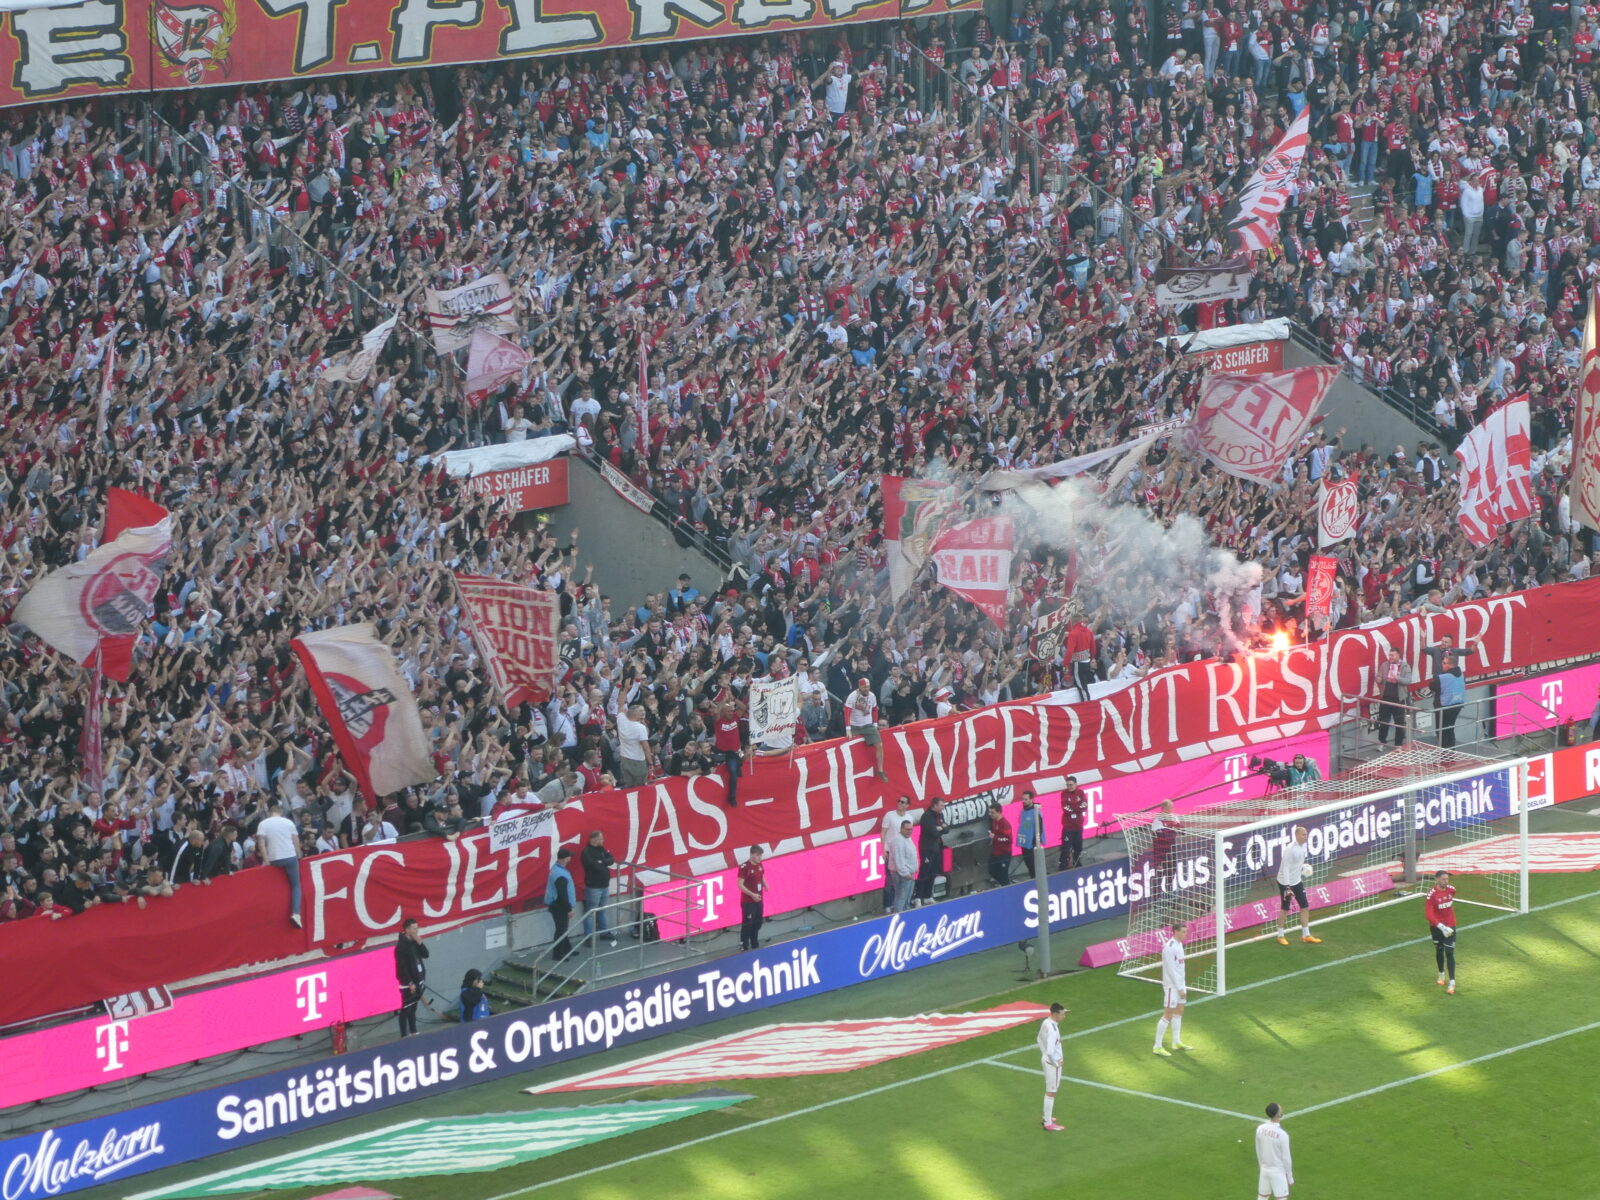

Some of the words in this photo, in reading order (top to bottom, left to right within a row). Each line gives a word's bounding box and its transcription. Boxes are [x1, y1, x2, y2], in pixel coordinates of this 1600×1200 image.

[1225, 345, 1269, 369] SCHÄFER
[495, 465, 550, 492] SCHÄFER
[1541, 679, 1563, 720] T
[309, 849, 405, 942] FC
[609, 773, 728, 870] JAS
[794, 737, 884, 830] HE
[893, 703, 1082, 800] WEED
[1096, 668, 1191, 761] NIT
[1204, 594, 1528, 733] RESIGNIERT
[1224, 752, 1248, 796] T
[1517, 797, 1548, 811] BDESLIGA
[493, 820, 520, 837] STARK
[858, 912, 985, 978] Malzkorn
[1245, 778, 1495, 872] Ortopädie-echnik
[860, 837, 886, 882] T
[696, 875, 724, 923] T
[296, 971, 328, 1022] T
[96, 1020, 129, 1073] T
[2, 1128, 165, 1200] Malzkorn
[216, 1047, 460, 1140] Sanitätshaus
[468, 1030, 498, 1074] &
[503, 946, 821, 1064] Orthopädie-Technik
